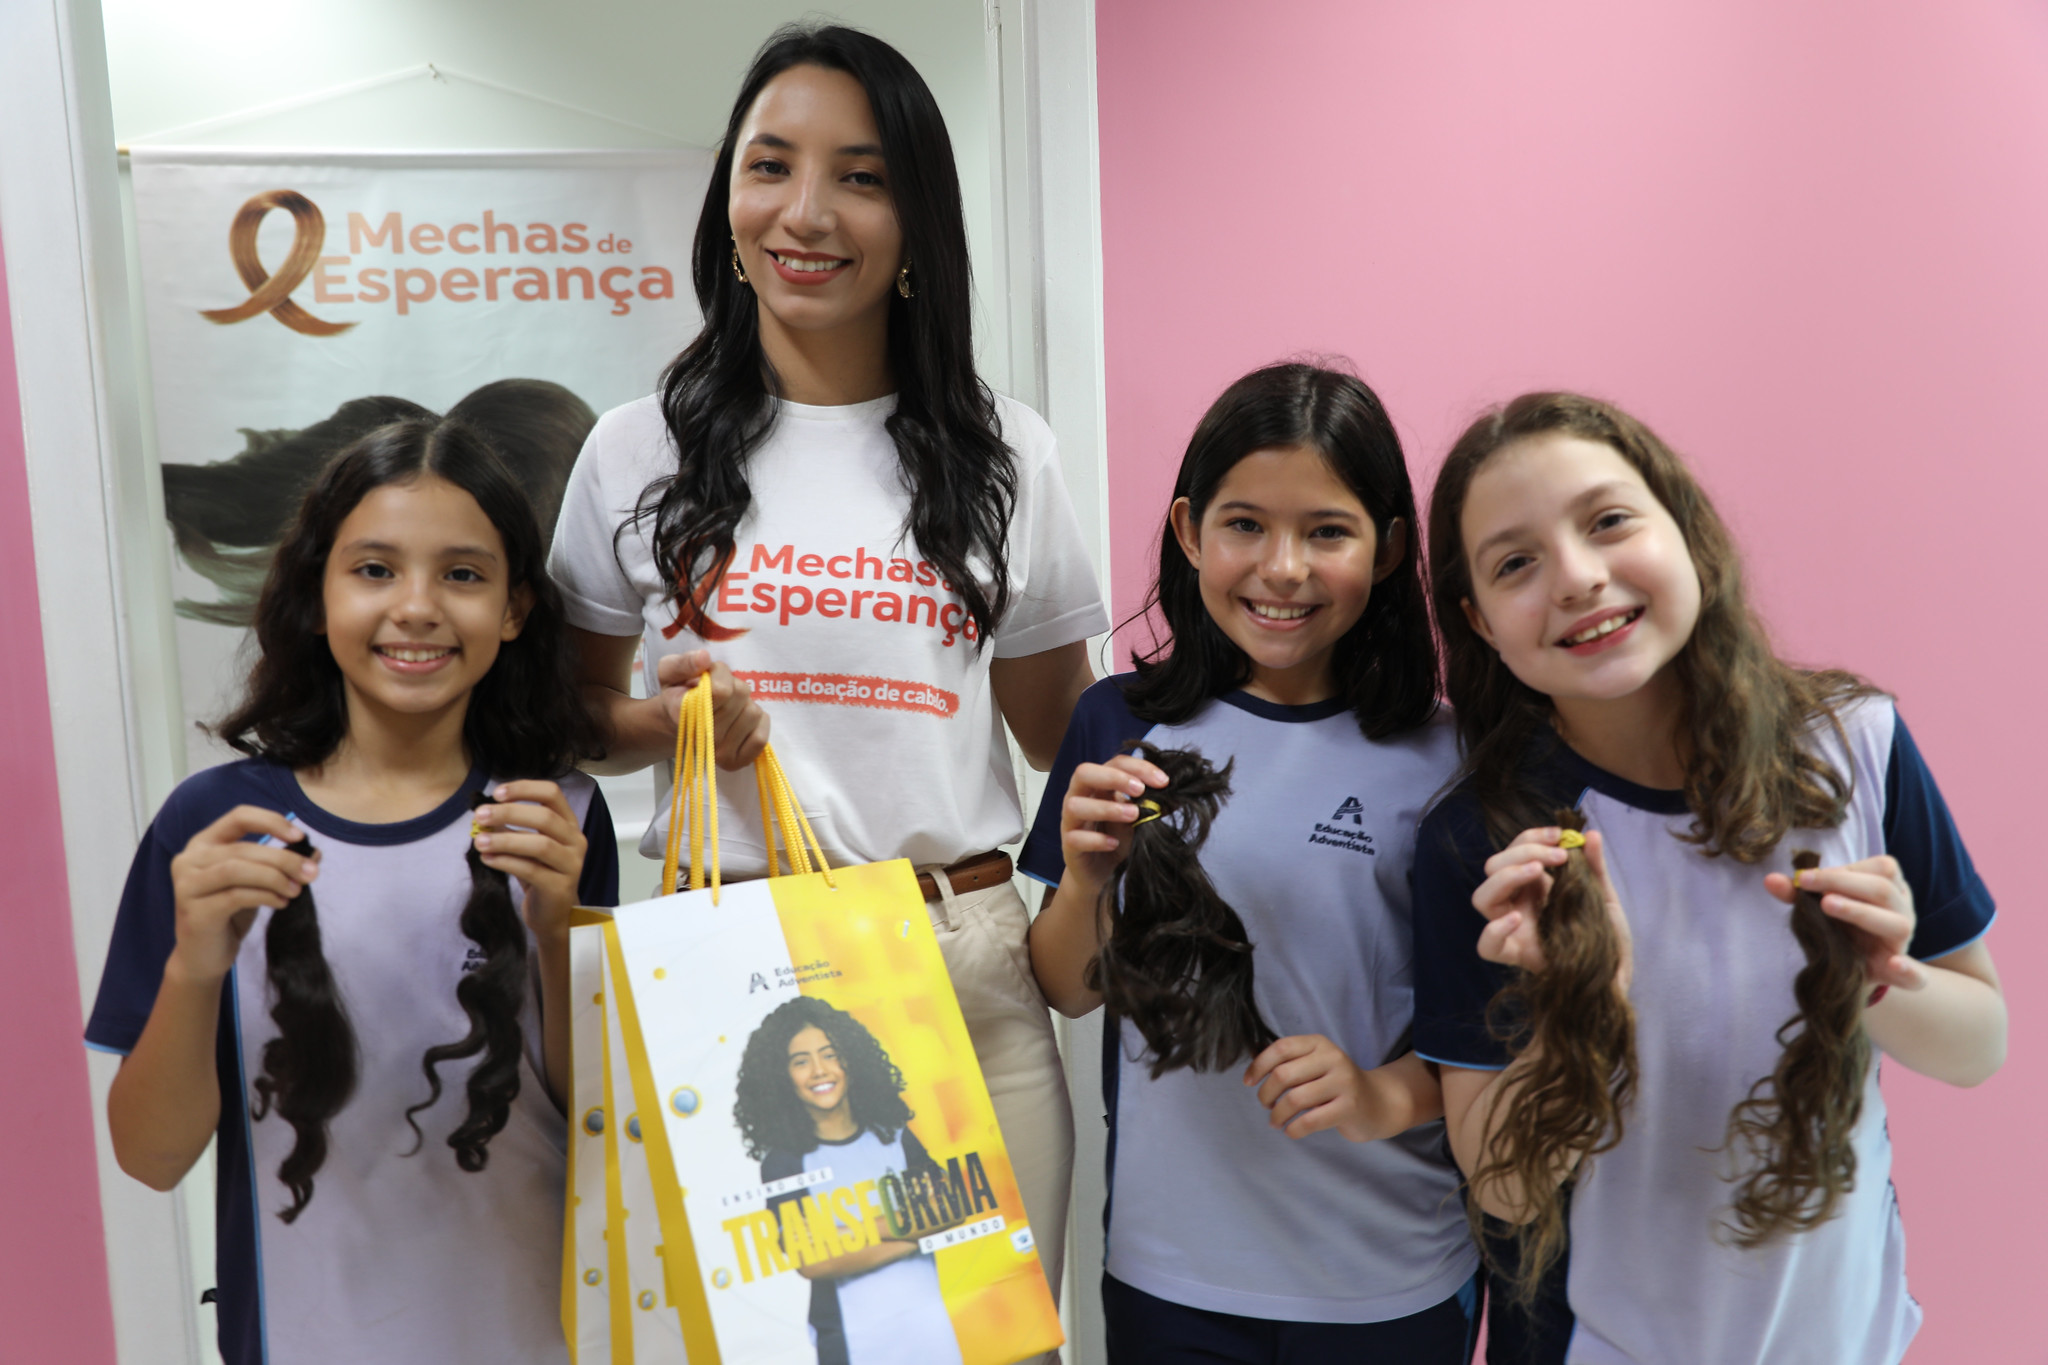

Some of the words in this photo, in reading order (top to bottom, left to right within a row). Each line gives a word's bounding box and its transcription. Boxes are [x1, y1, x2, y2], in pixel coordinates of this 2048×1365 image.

[347, 210, 590, 255] Mechas
[597, 234, 632, 254] de
[312, 256, 675, 316] Esperança
[750, 544, 938, 587] Mechas
[717, 572, 978, 647] Esperança
[759, 679, 793, 694] sua
[797, 678, 871, 701] doação
[874, 684, 900, 702] de
[1308, 833, 1375, 855] Adventista
[1314, 823, 1373, 843] Educação
[774, 960, 830, 977] Educação
[779, 969, 843, 988] Adventista
[722, 1181, 785, 1207] ENSINO
[797, 1170, 827, 1187] QUE
[925, 1238, 934, 1250] O
[945, 1218, 1001, 1243] MUNDO
